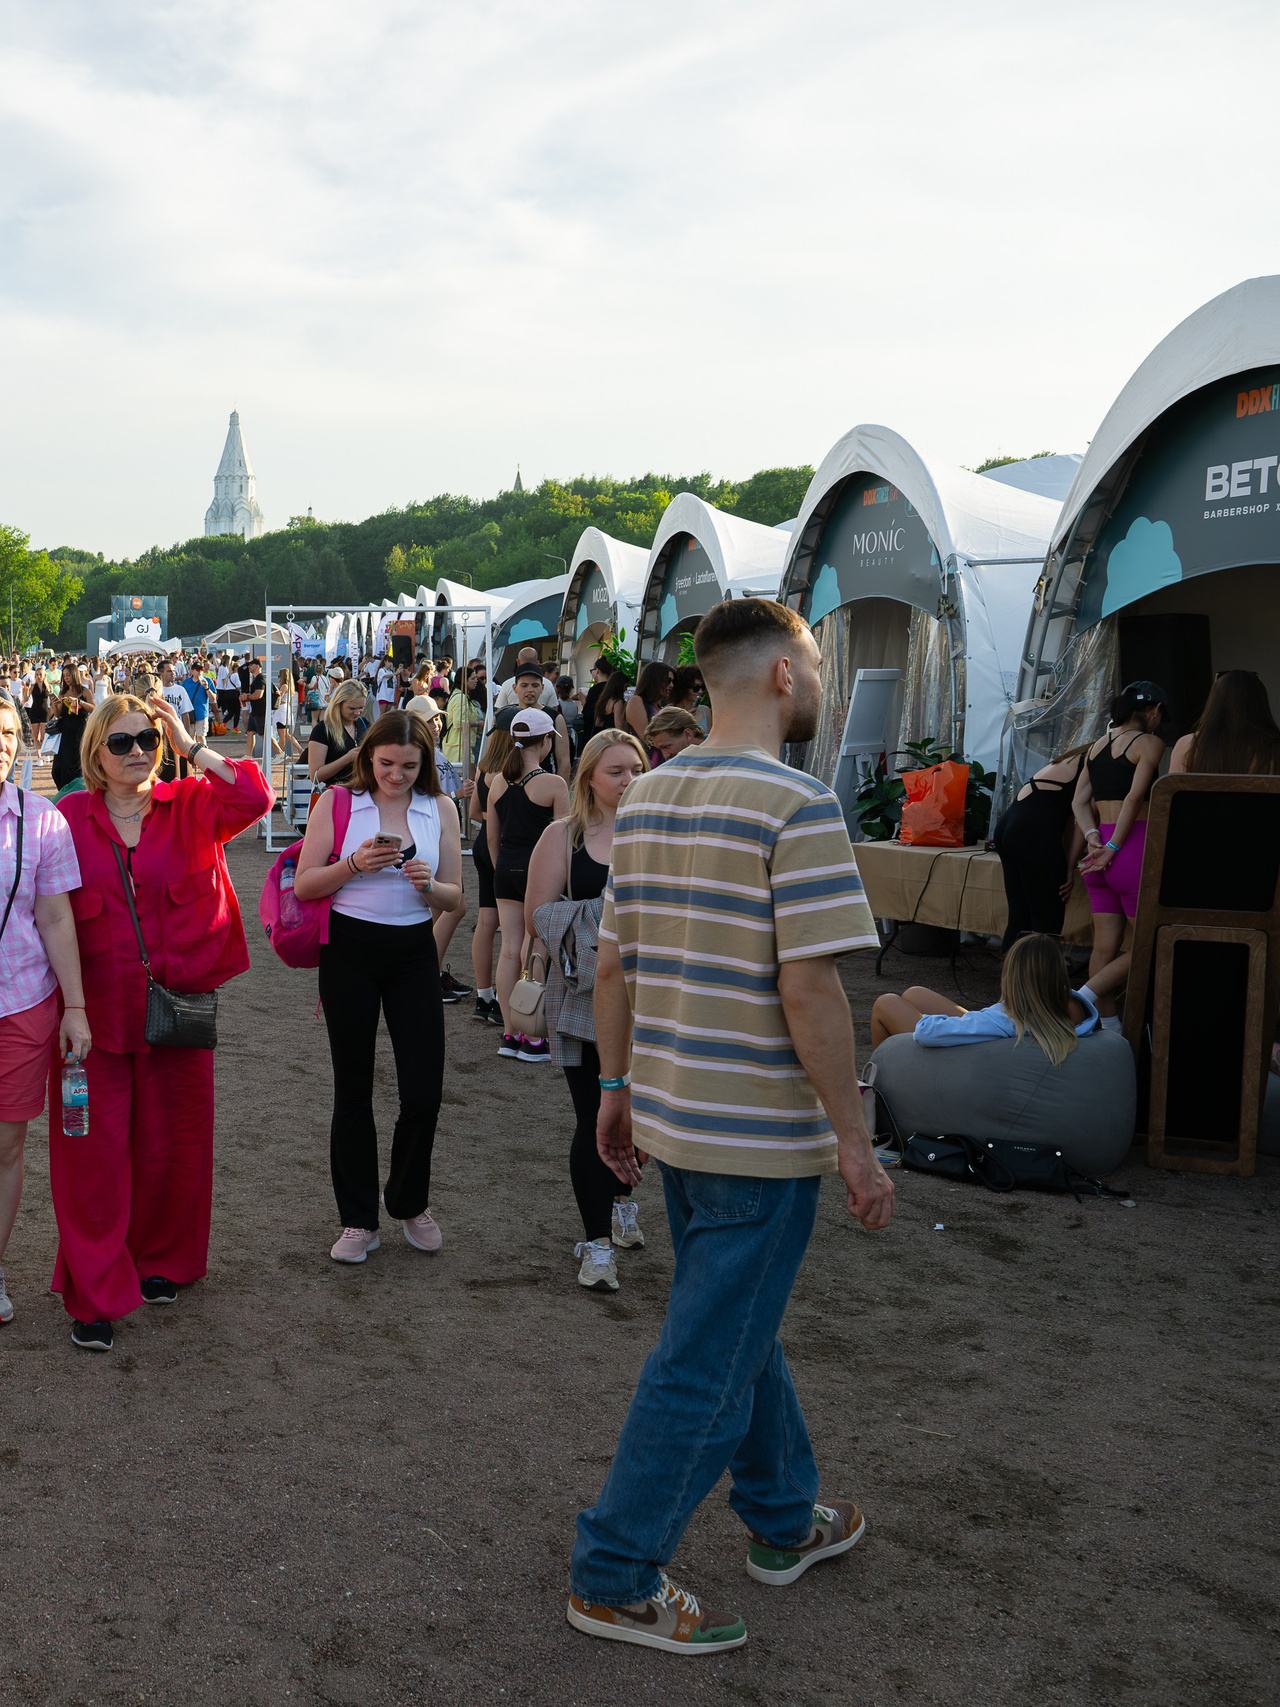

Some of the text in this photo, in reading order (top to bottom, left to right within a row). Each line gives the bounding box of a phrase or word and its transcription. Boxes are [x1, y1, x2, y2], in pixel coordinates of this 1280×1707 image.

[1236, 383, 1280, 418] DDXFI
[1205, 455, 1280, 501] BET
[1203, 503, 1270, 519] BARBERSHOP
[860, 557, 894, 567] BEAUTY
[136, 624, 149, 633] GJ
